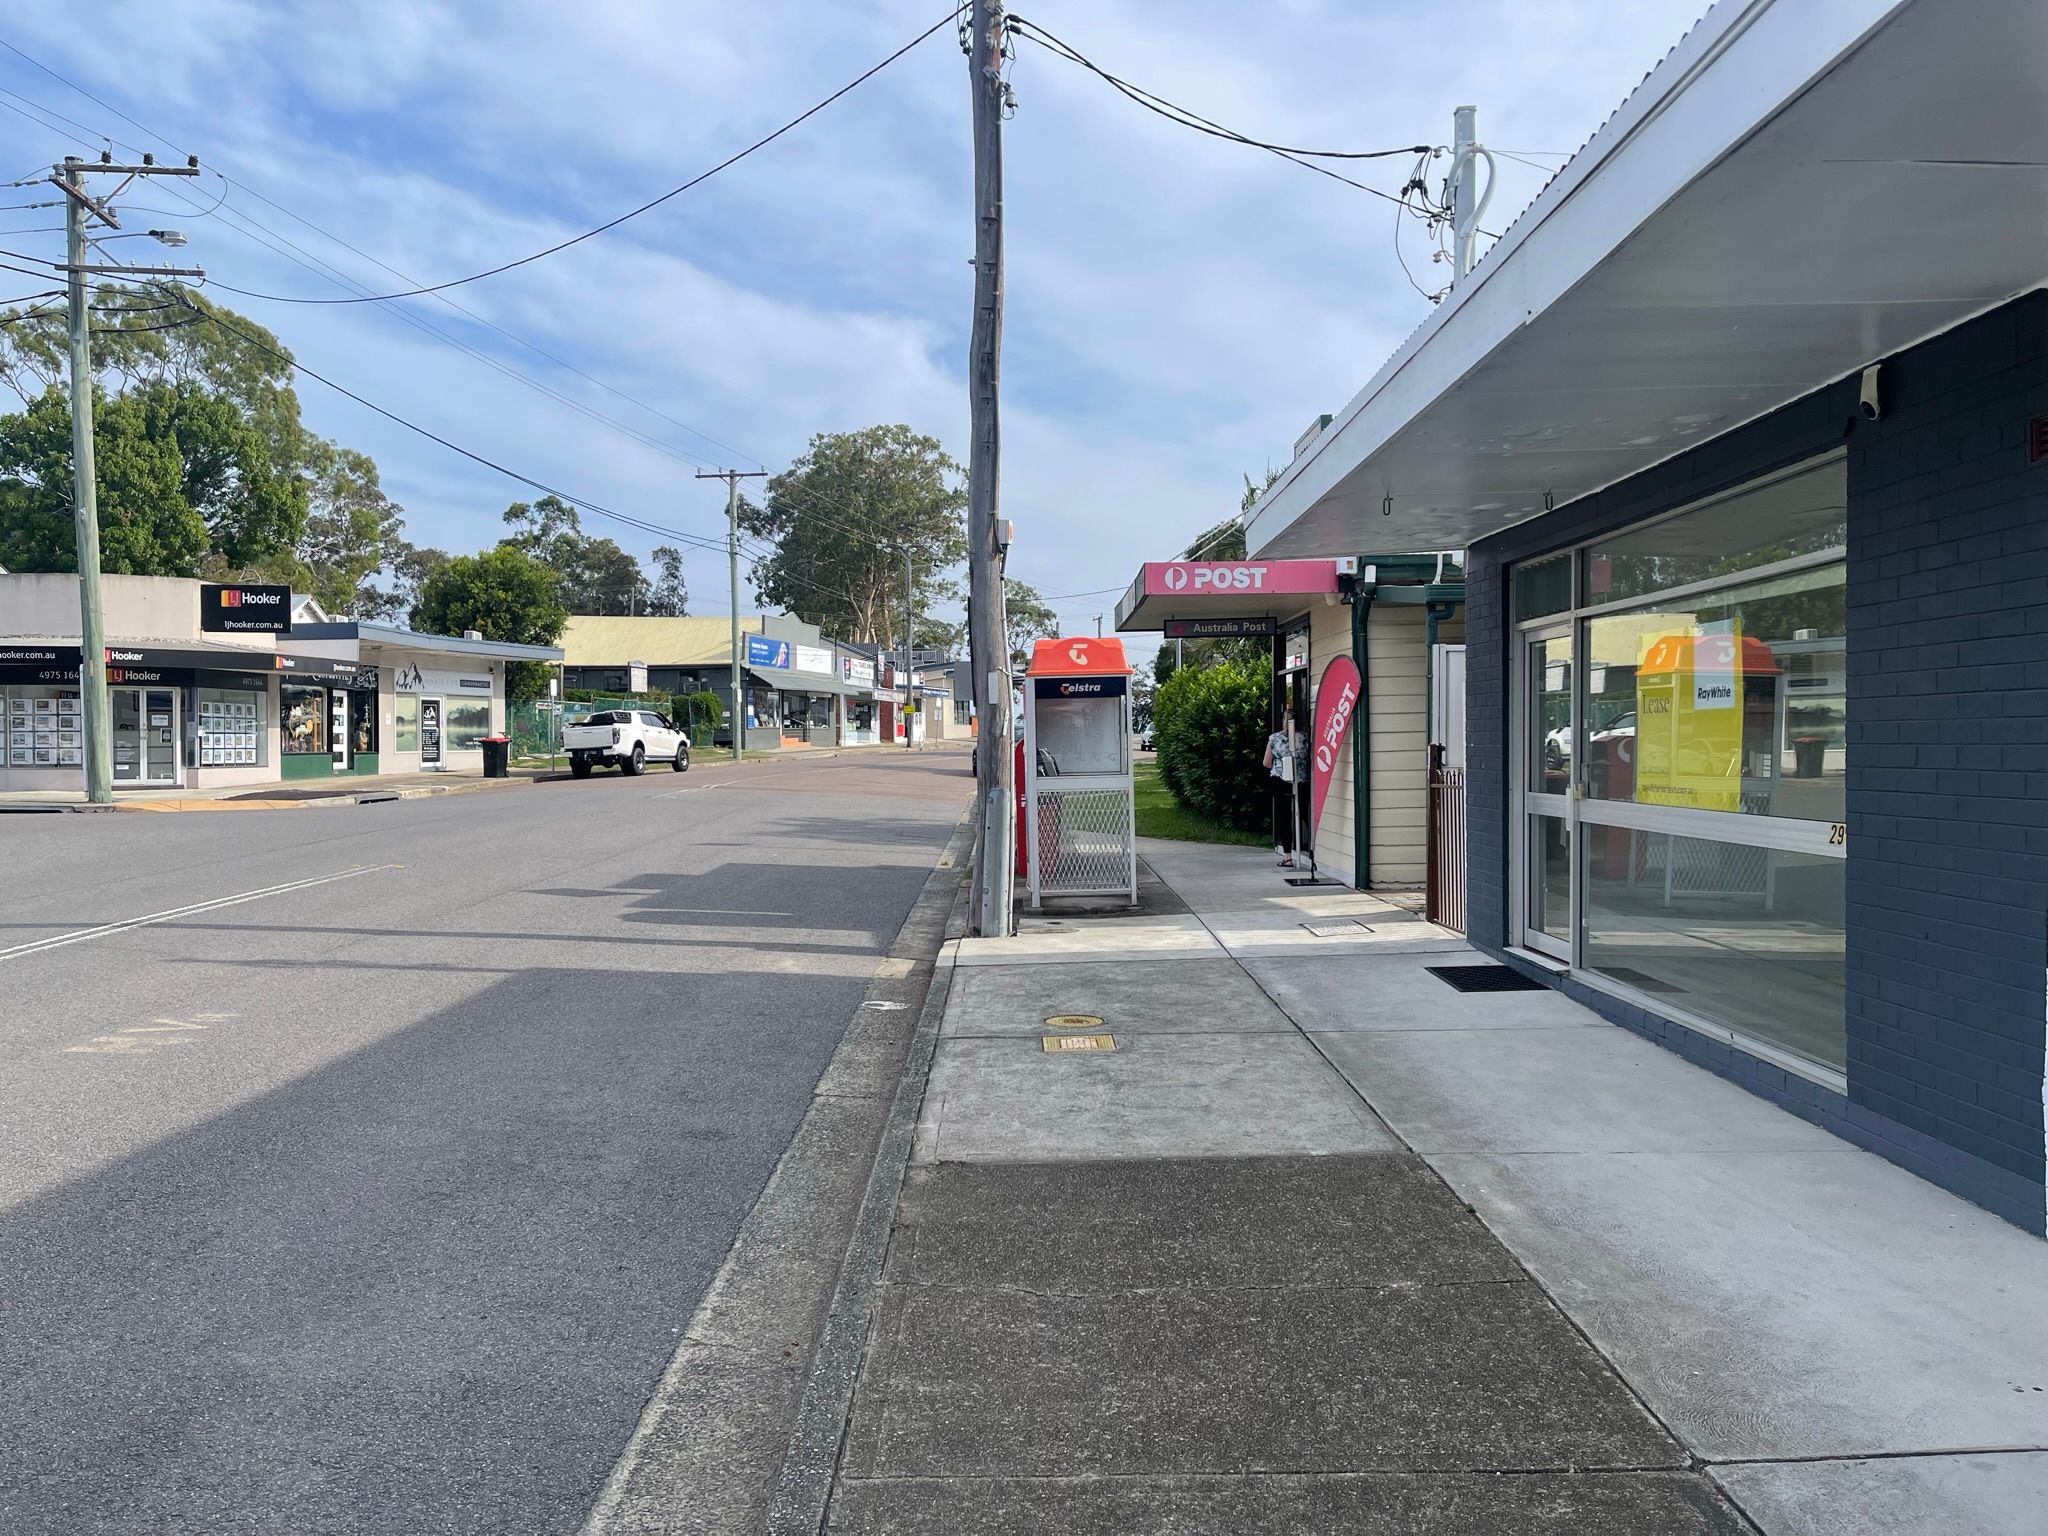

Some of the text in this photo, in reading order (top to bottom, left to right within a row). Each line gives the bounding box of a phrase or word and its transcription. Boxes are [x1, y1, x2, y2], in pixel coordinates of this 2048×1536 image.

[1195, 567, 1267, 589] POST
[242, 592, 281, 605] Hooker
[224, 620, 283, 630] ljhooker.com.au
[1193, 621, 1266, 633] Australia Post
[111, 651, 143, 660] Hooker
[39, 671, 61, 679] 4975
[125, 670, 160, 681] Hooker
[1060, 683, 1101, 695] Telstra
[1697, 685, 1731, 701] RayWhite
[1642, 694, 1670, 714] Lease
[1326, 682, 1355, 750] POST
[1323, 707, 1336, 739] AUSTRALIA
[1829, 824, 1845, 845] 29
